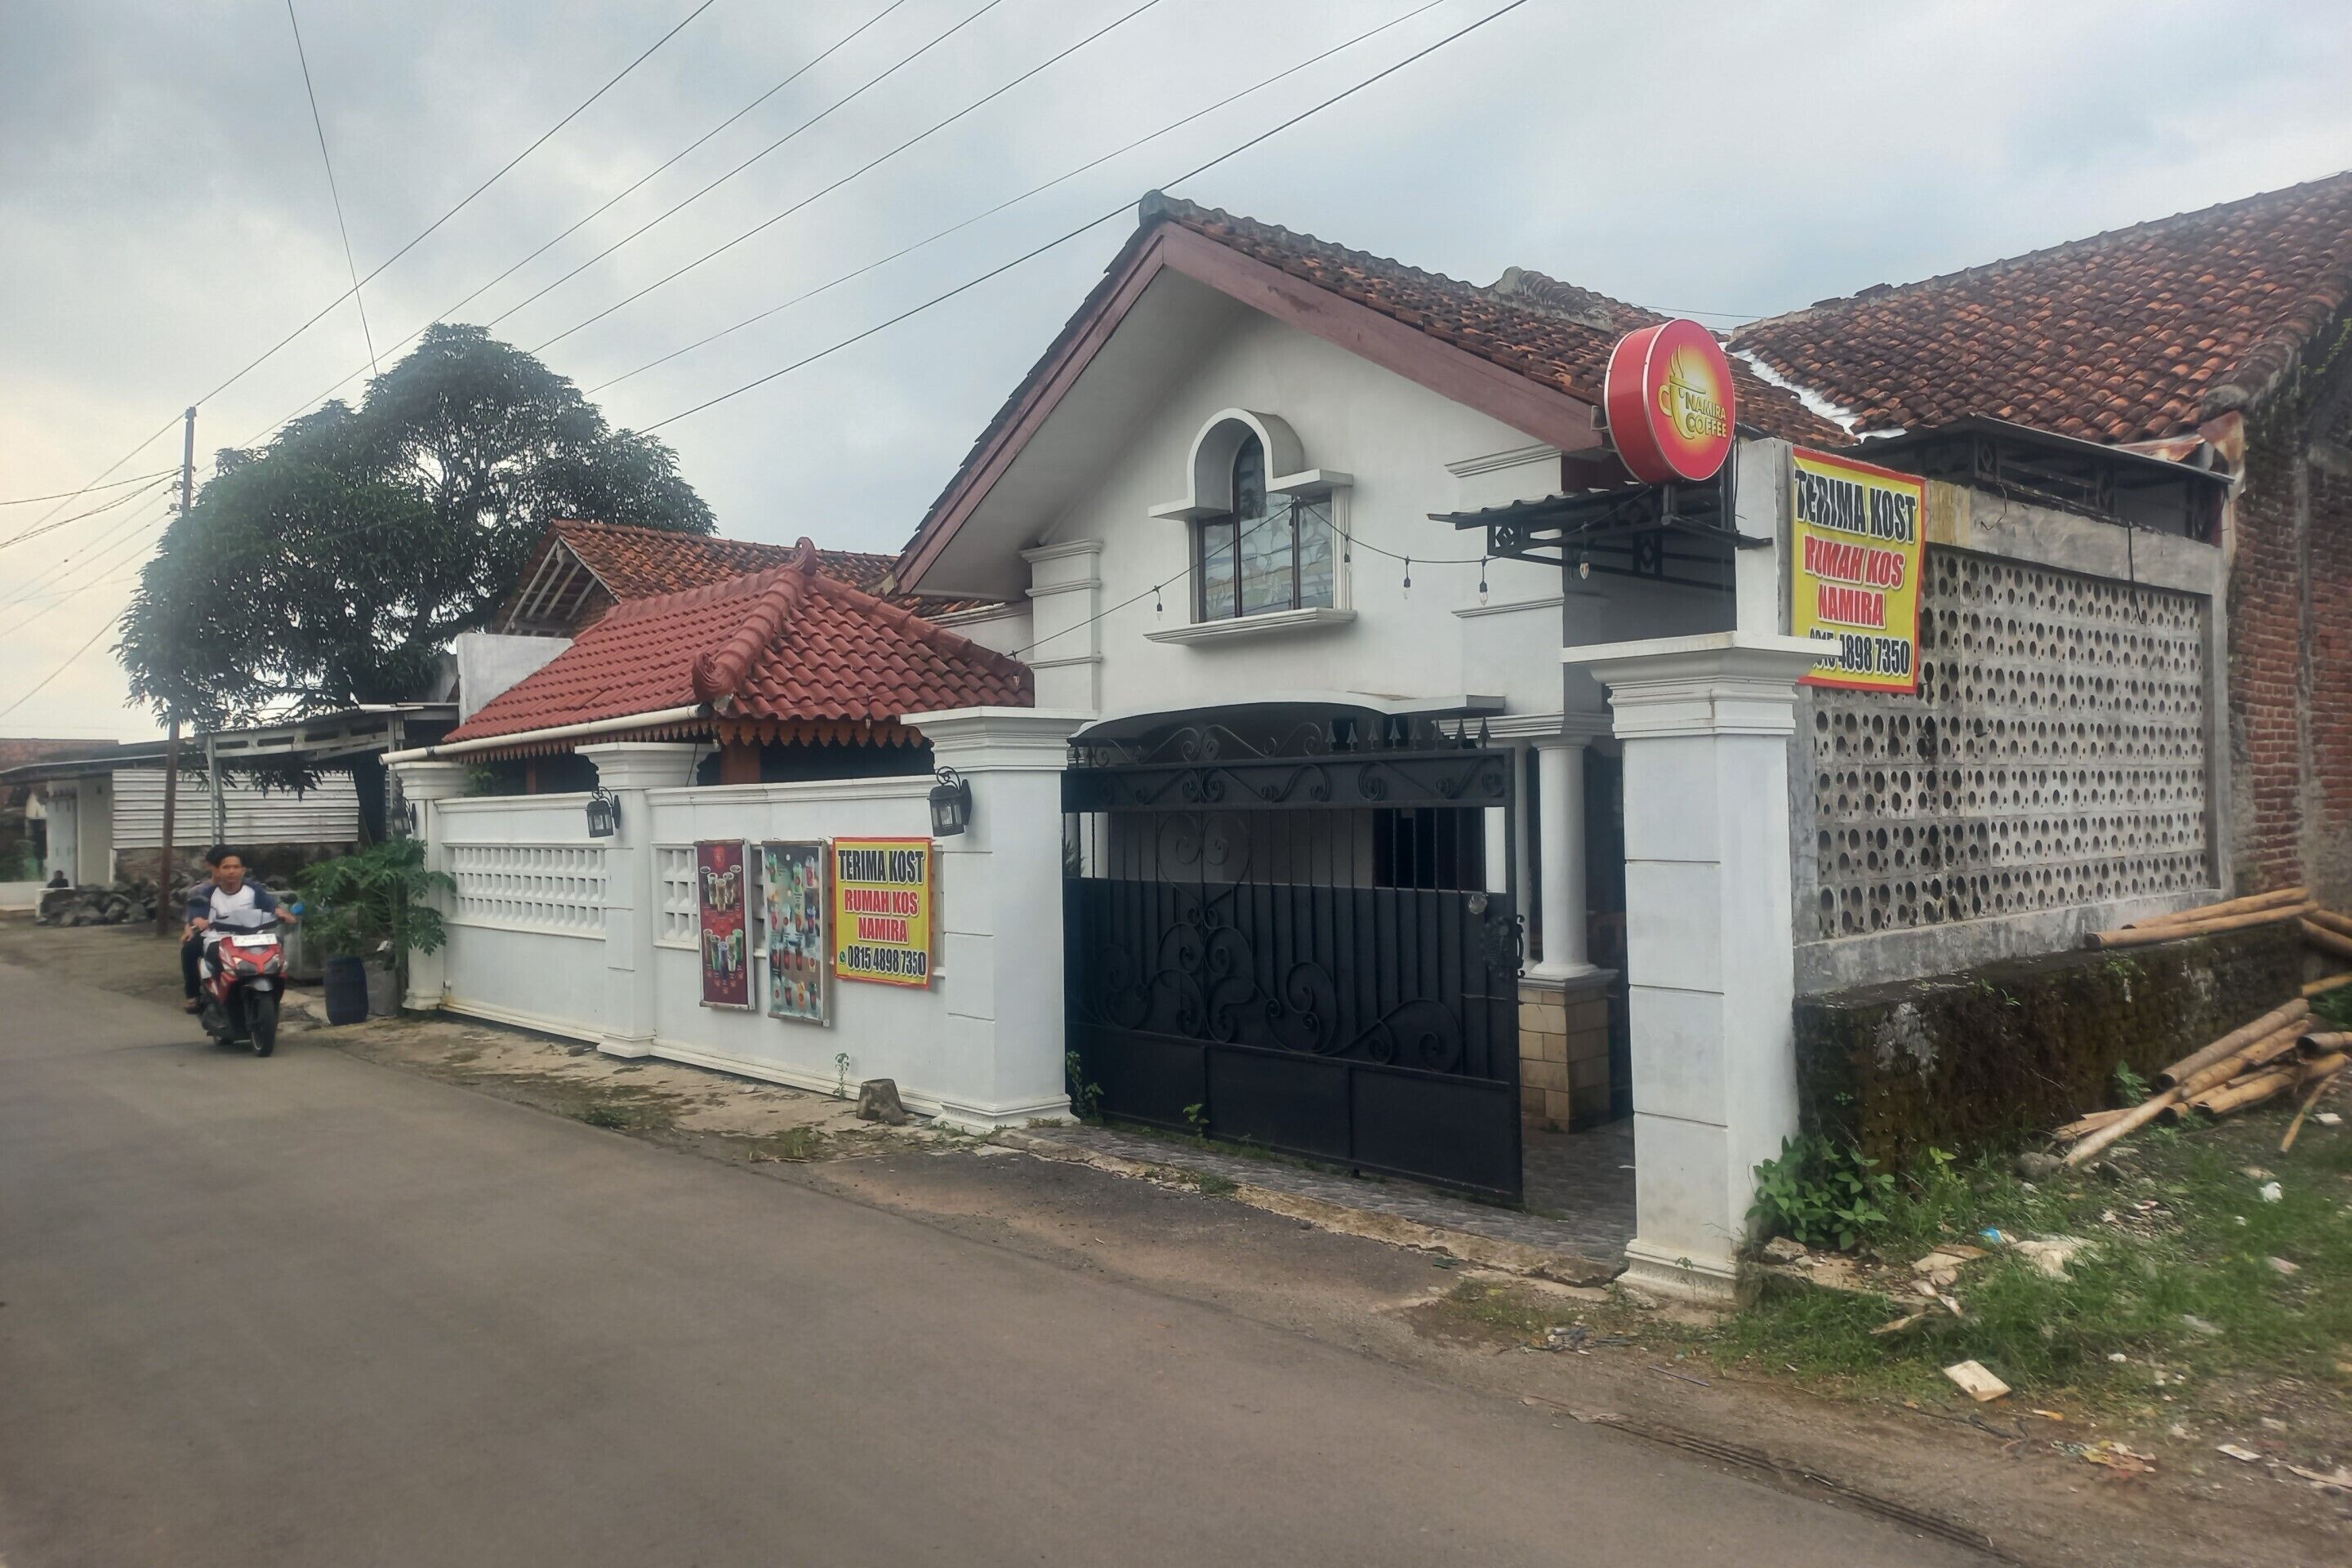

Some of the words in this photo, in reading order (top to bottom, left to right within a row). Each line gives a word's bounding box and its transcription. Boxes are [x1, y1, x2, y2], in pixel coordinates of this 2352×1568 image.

[1686, 391, 1726, 421] NAMIRA
[1686, 412, 1726, 439] COFFEE
[1795, 470, 1866, 533] TERIMA
[1869, 488, 1916, 542] KOST
[1805, 536, 1865, 581] RUMAH
[1865, 550, 1904, 587] KOS
[1819, 584, 1884, 626] NAMIRA
[1875, 638, 1910, 675] 7350
[838, 849, 886, 881] TERIMA
[889, 850, 924, 883] KOST
[844, 889, 889, 913] RUMAH
[892, 891, 918, 915] KOS
[858, 916, 908, 942] NAMIRA
[848, 945, 871, 970] 0815
[873, 947, 899, 973] 4898
[901, 950, 927, 976] 7350
